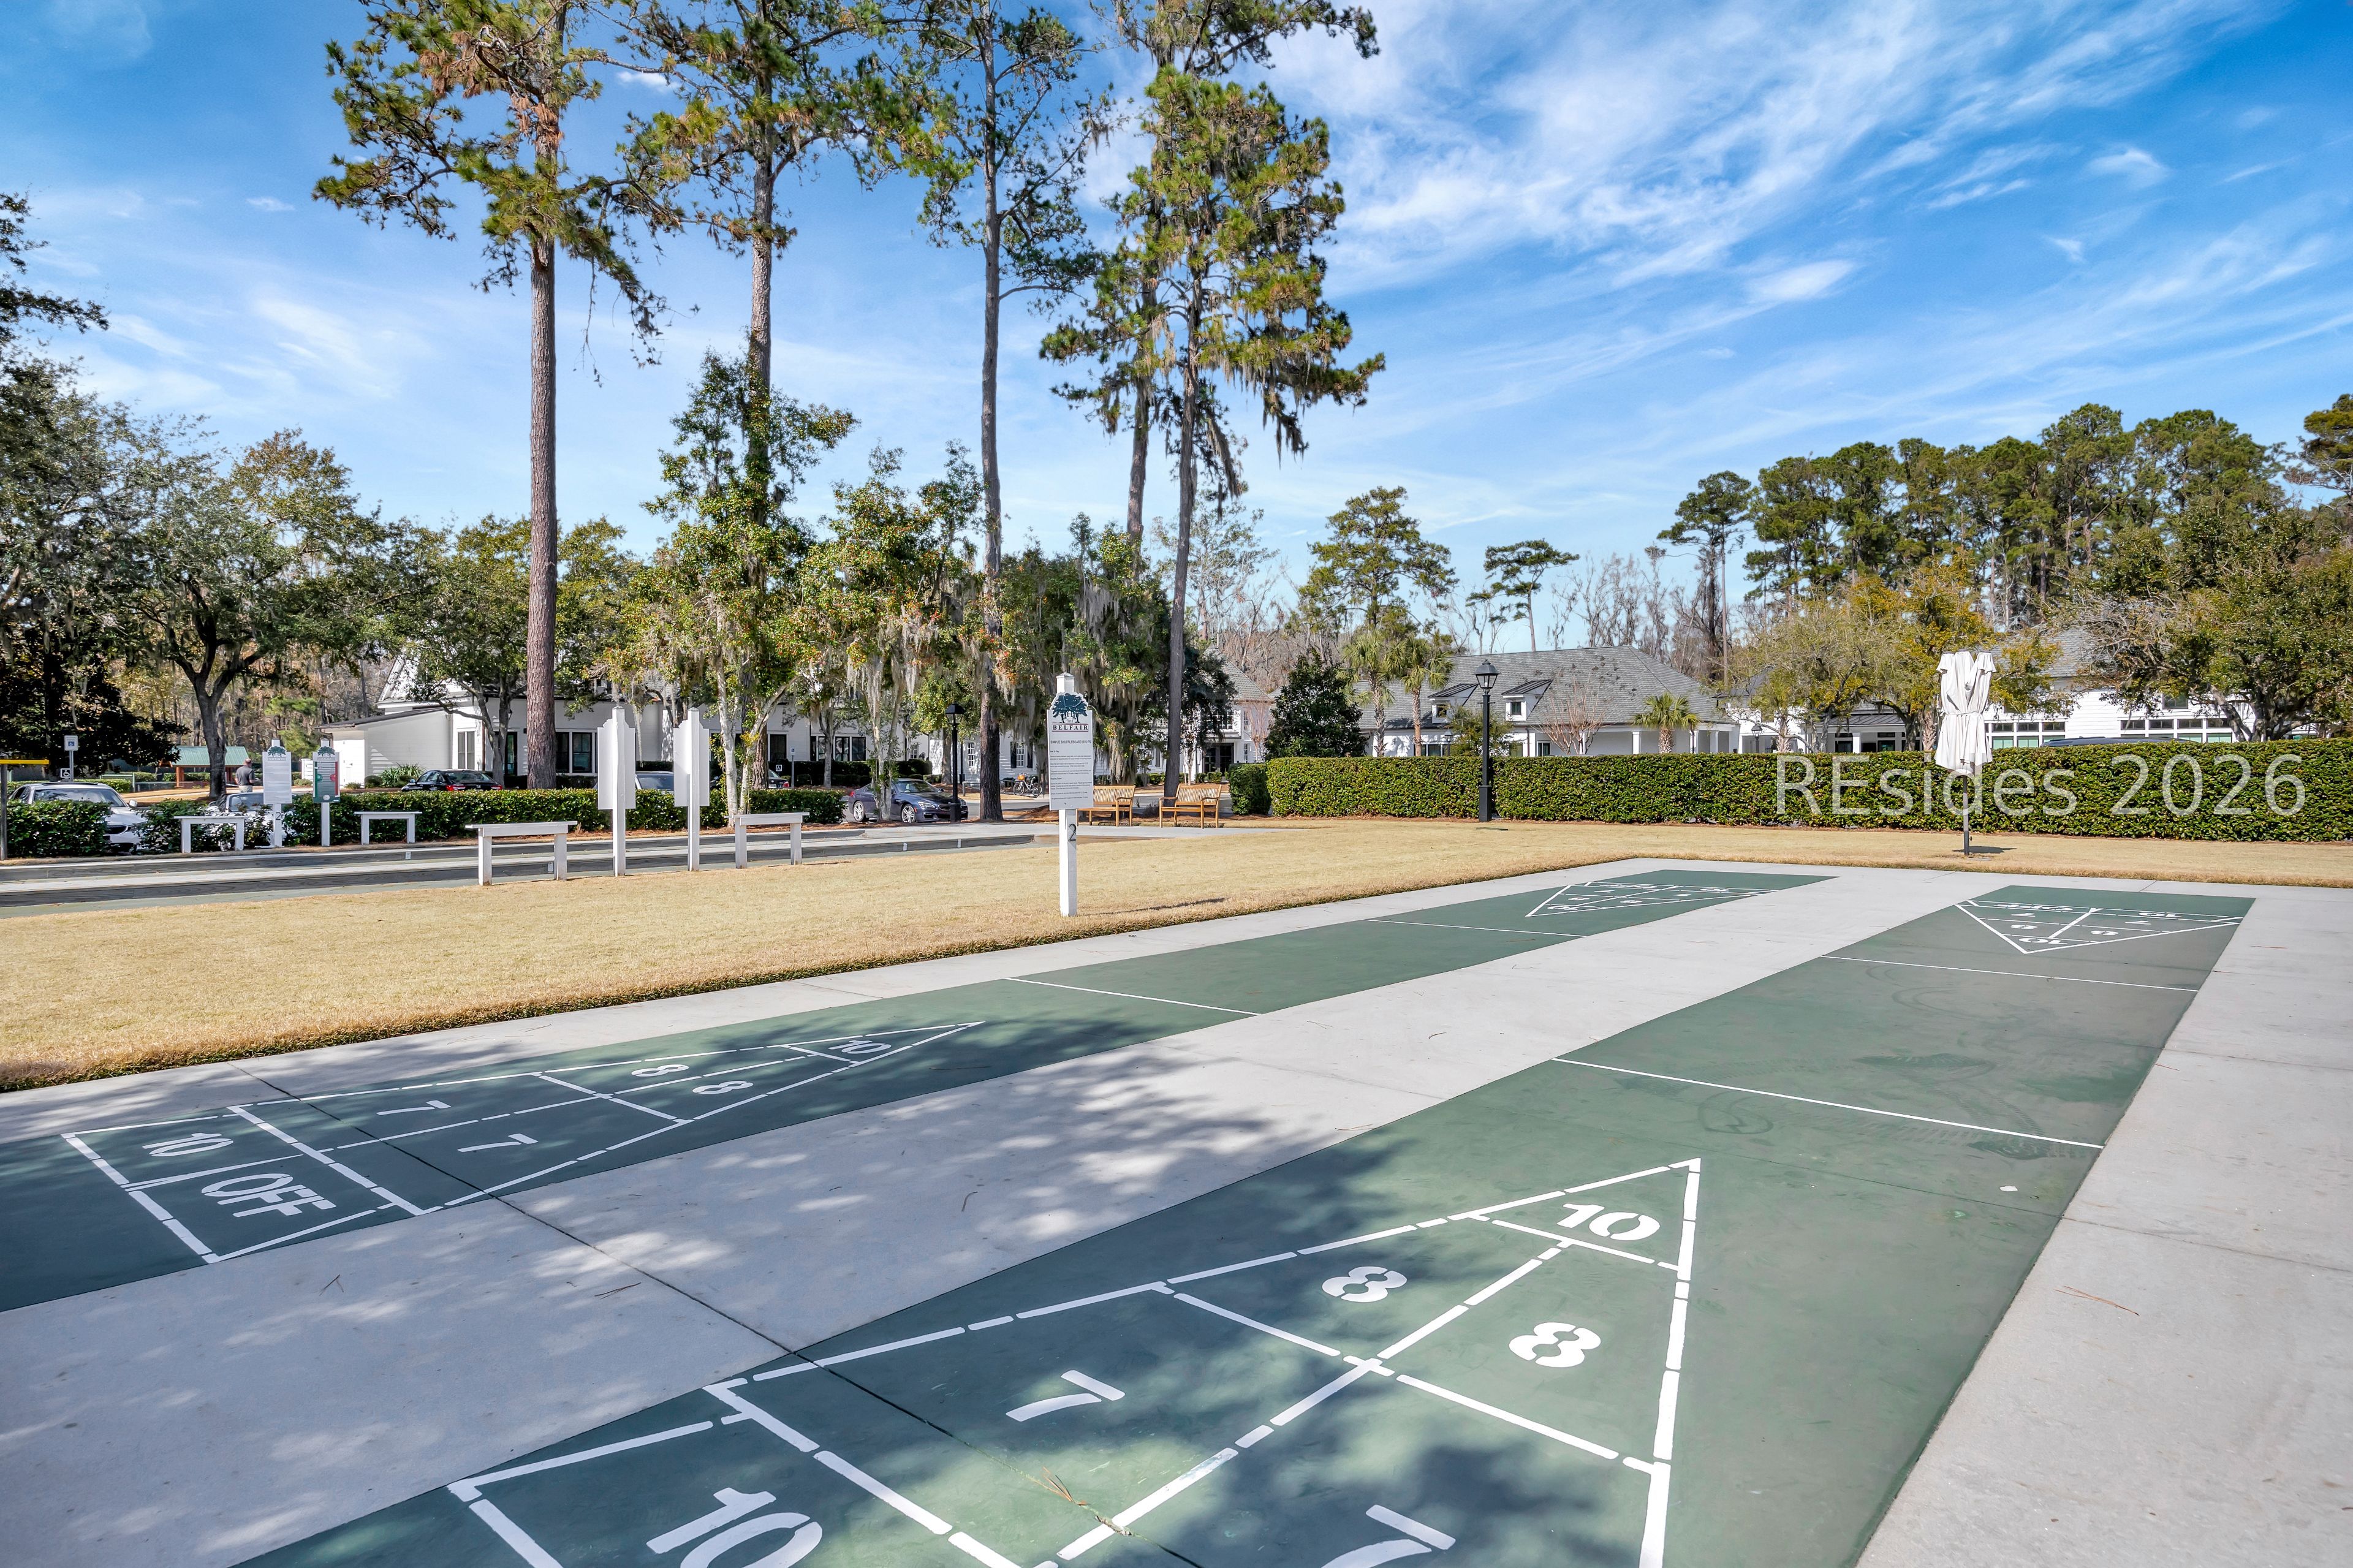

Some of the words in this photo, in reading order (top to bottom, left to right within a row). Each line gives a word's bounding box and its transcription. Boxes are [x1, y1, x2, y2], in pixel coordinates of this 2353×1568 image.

[1069, 824, 1076, 841] 2
[828, 1039, 892, 1054] 10
[631, 1064, 689, 1077] 8
[692, 1080, 754, 1095] 8
[376, 1100, 452, 1116] 7
[457, 1133, 539, 1153] 7
[142, 1132, 234, 1157] 10
[201, 1173, 337, 1218] OFF
[1556, 1203, 1661, 1241] 10
[1322, 1266, 1408, 1303] 8
[1509, 1322, 1601, 1368] 8
[1006, 1369, 1126, 1422] 7
[646, 1487, 823, 1568] 10
[1320, 1504, 1456, 1568] 7
